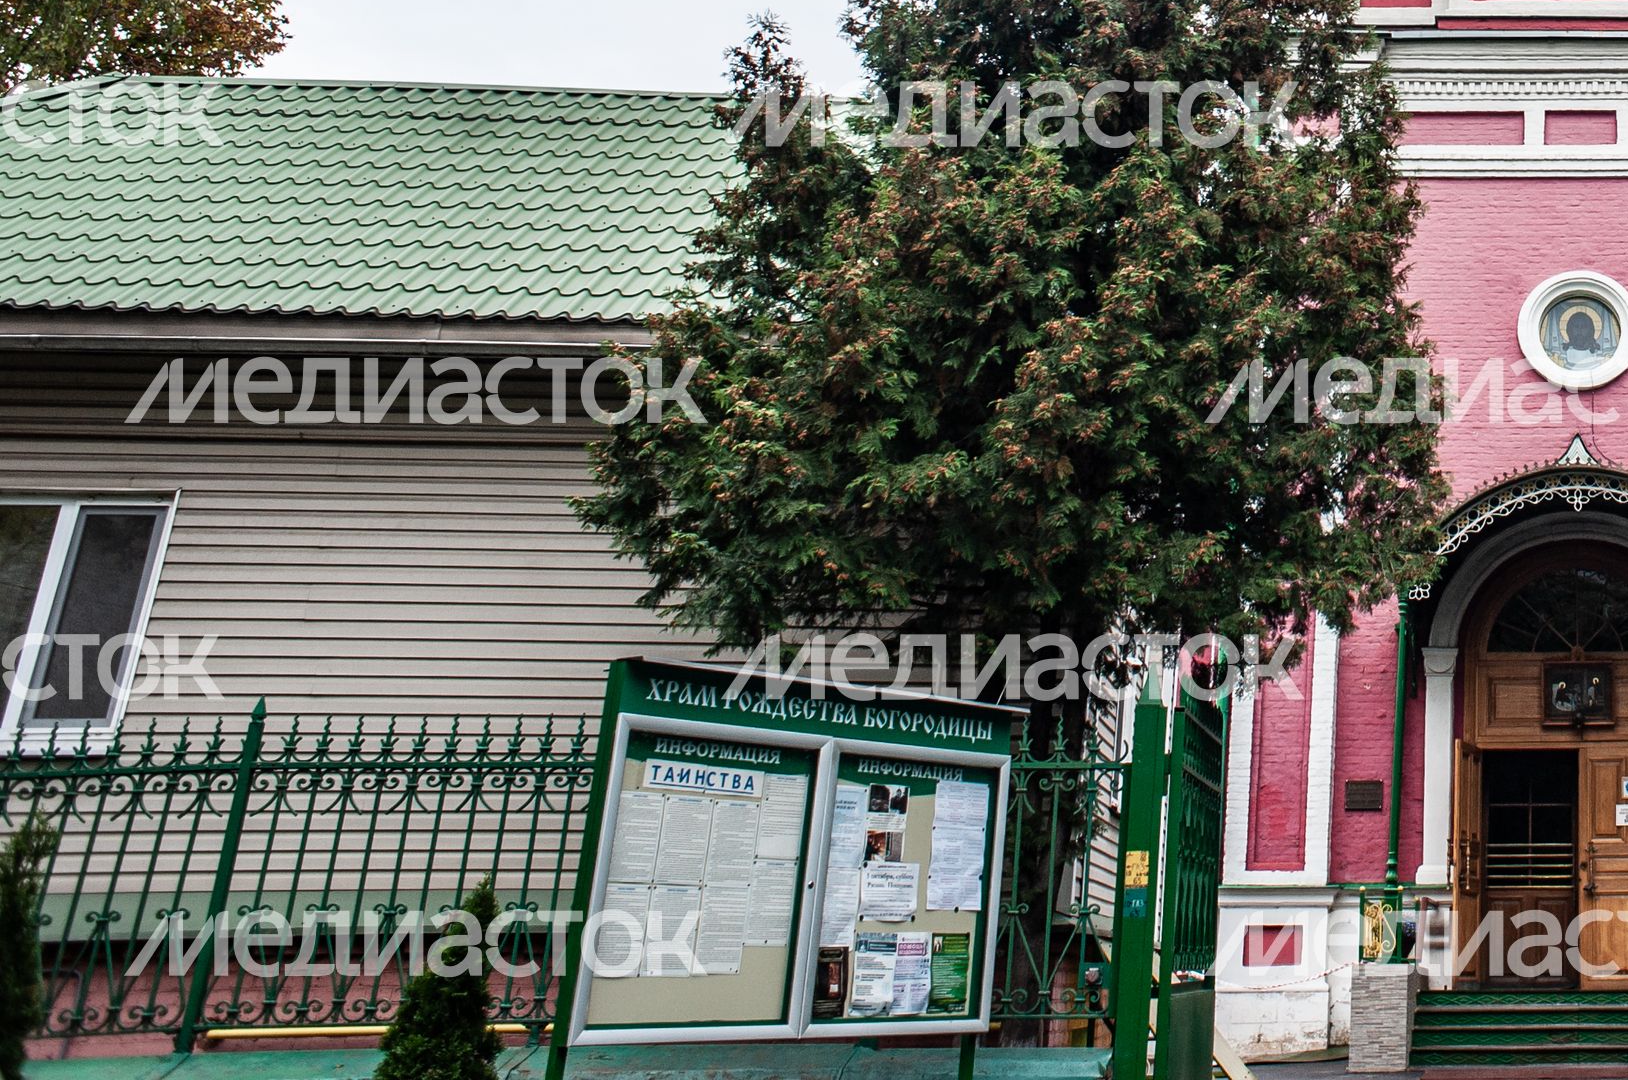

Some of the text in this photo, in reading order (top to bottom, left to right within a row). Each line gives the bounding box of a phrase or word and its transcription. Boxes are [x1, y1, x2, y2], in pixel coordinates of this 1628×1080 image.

[646, 678, 993, 743] ХРАМ РОЖДЕСТВА БОГОРОДИЦЫ
[654, 737, 781, 765] ИНФОРМАЦИЯ
[651, 765, 754, 791] ТАИНСТВА
[857, 759, 963, 782] ИНФОРМАЦИЯ
